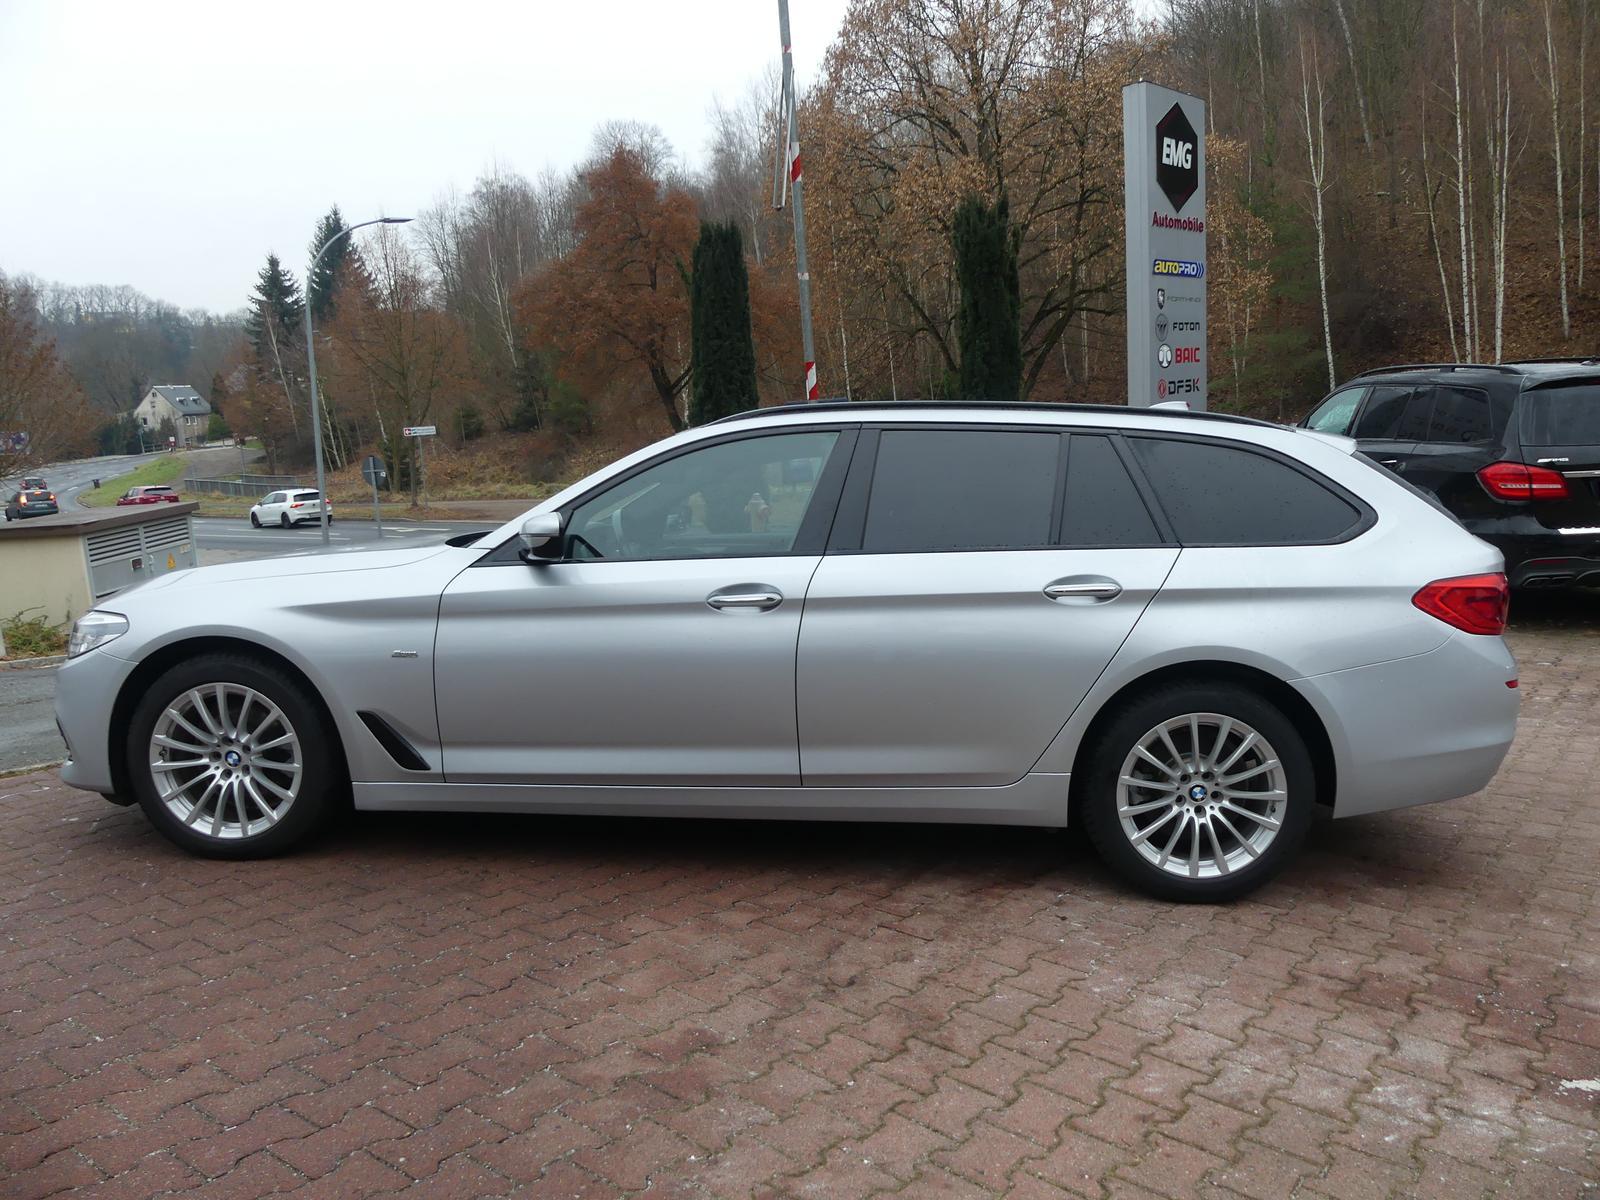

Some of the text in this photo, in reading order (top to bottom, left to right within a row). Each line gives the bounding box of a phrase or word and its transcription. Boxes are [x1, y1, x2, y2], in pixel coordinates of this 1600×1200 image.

[1162, 137, 1193, 170] EMG
[1152, 211, 1204, 233] Automobile
[1175, 347, 1201, 364] BAIC
[1168, 377, 1200, 395] DFSK
